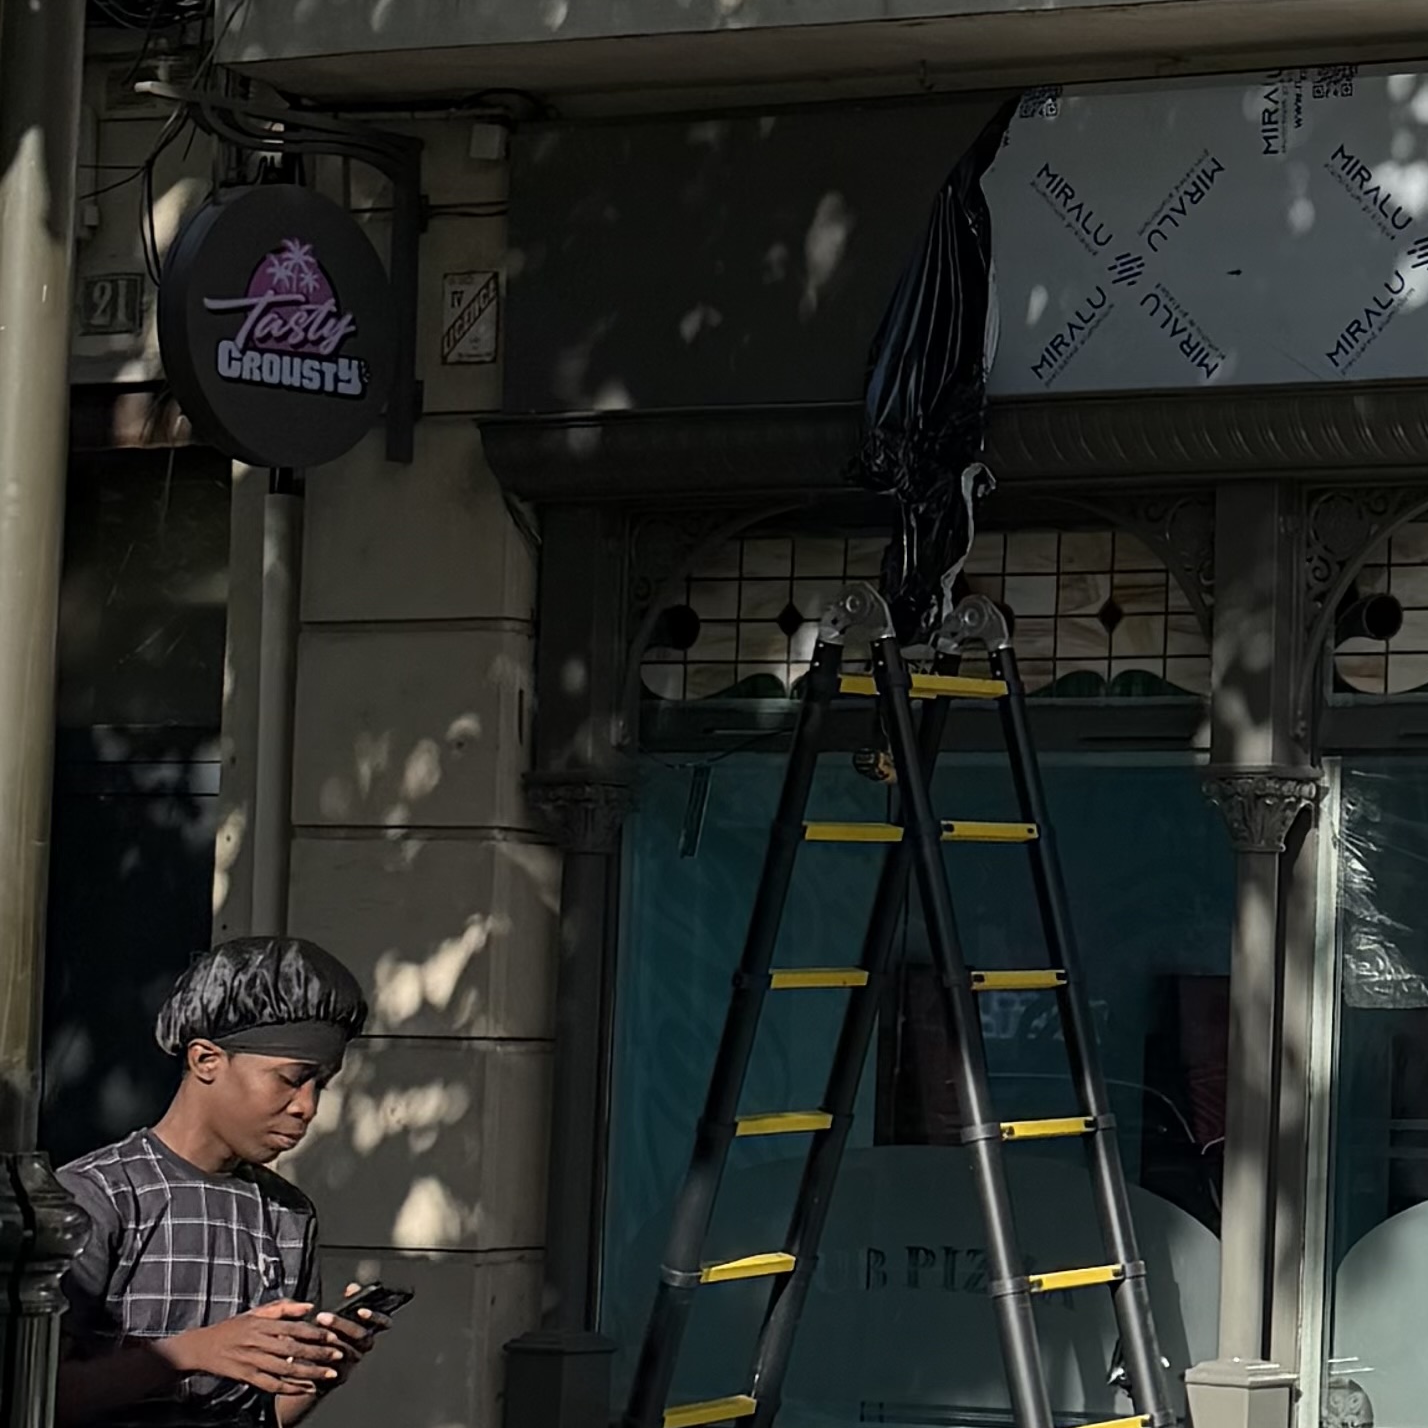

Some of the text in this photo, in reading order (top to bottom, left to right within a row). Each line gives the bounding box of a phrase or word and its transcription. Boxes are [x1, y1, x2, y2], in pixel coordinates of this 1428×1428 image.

[1036, 163, 1113, 246] MIRALU
[1147, 157, 1225, 252] MIRALU
[1331, 143, 1413, 230] MIRALU
[91, 280, 129, 326] 21
[203, 289, 357, 356] Tasty
[1031, 286, 1107, 380] MIRALU
[1140, 292, 1220, 379] MIRALU
[1325, 270, 1405, 367] MIRALU
